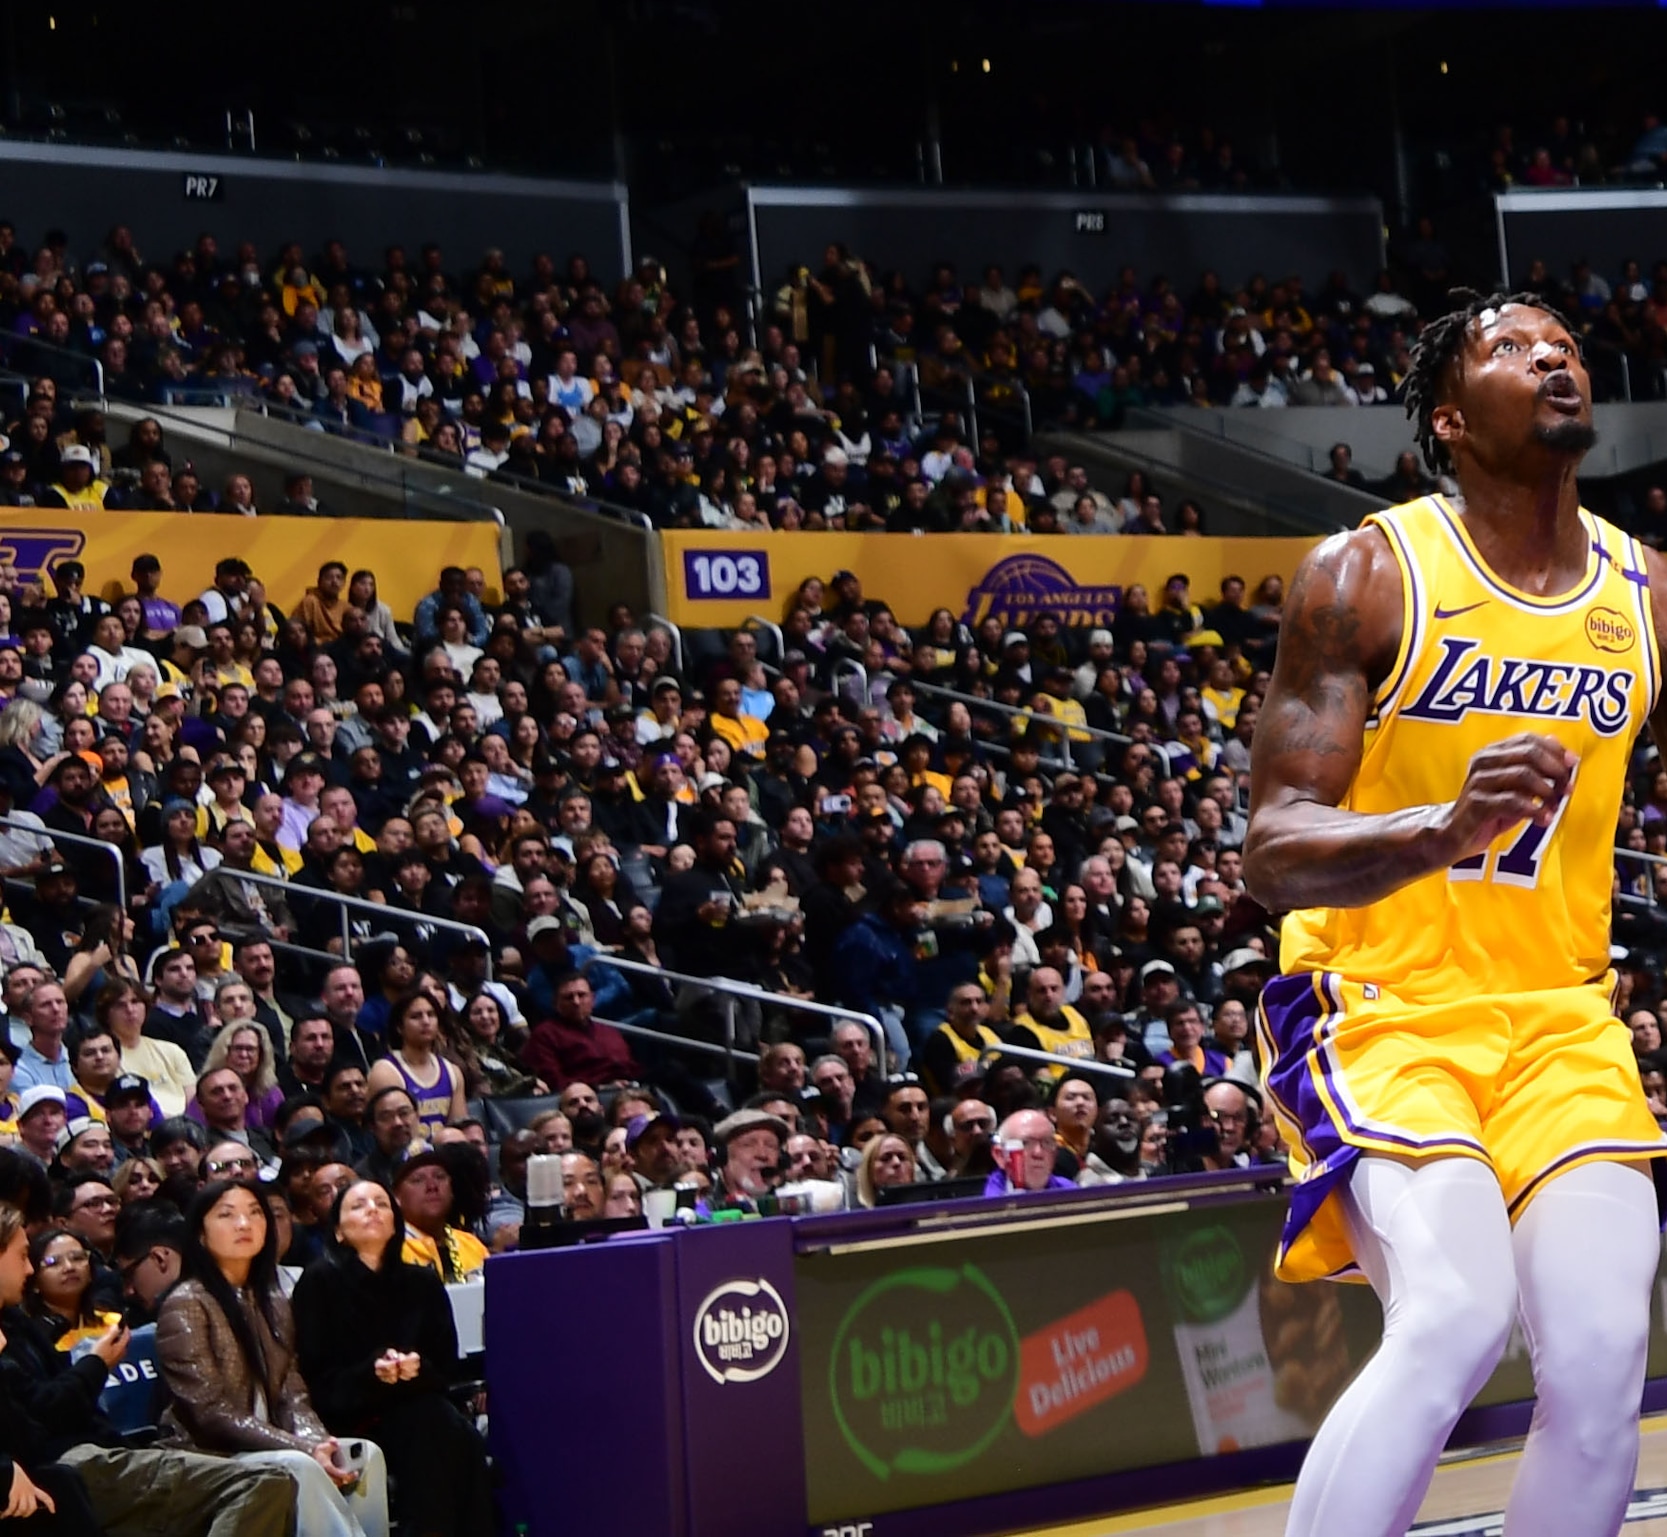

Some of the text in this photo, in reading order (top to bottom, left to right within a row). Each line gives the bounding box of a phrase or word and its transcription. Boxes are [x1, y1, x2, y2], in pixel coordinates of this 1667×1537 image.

[693, 556, 763, 594] 103
[1007, 592, 1115, 605] LOS ANGELES
[1589, 616, 1632, 639] bibigo
[1400, 636, 1637, 737] LAKERS
[1447, 758, 1580, 889] 7
[703, 1302, 782, 1350] bibigo
[1052, 1323, 1100, 1365] Live
[718, 1341, 753, 1361] 비비고
[848, 1321, 1007, 1406] bibigo
[1030, 1340, 1138, 1419] Delicious
